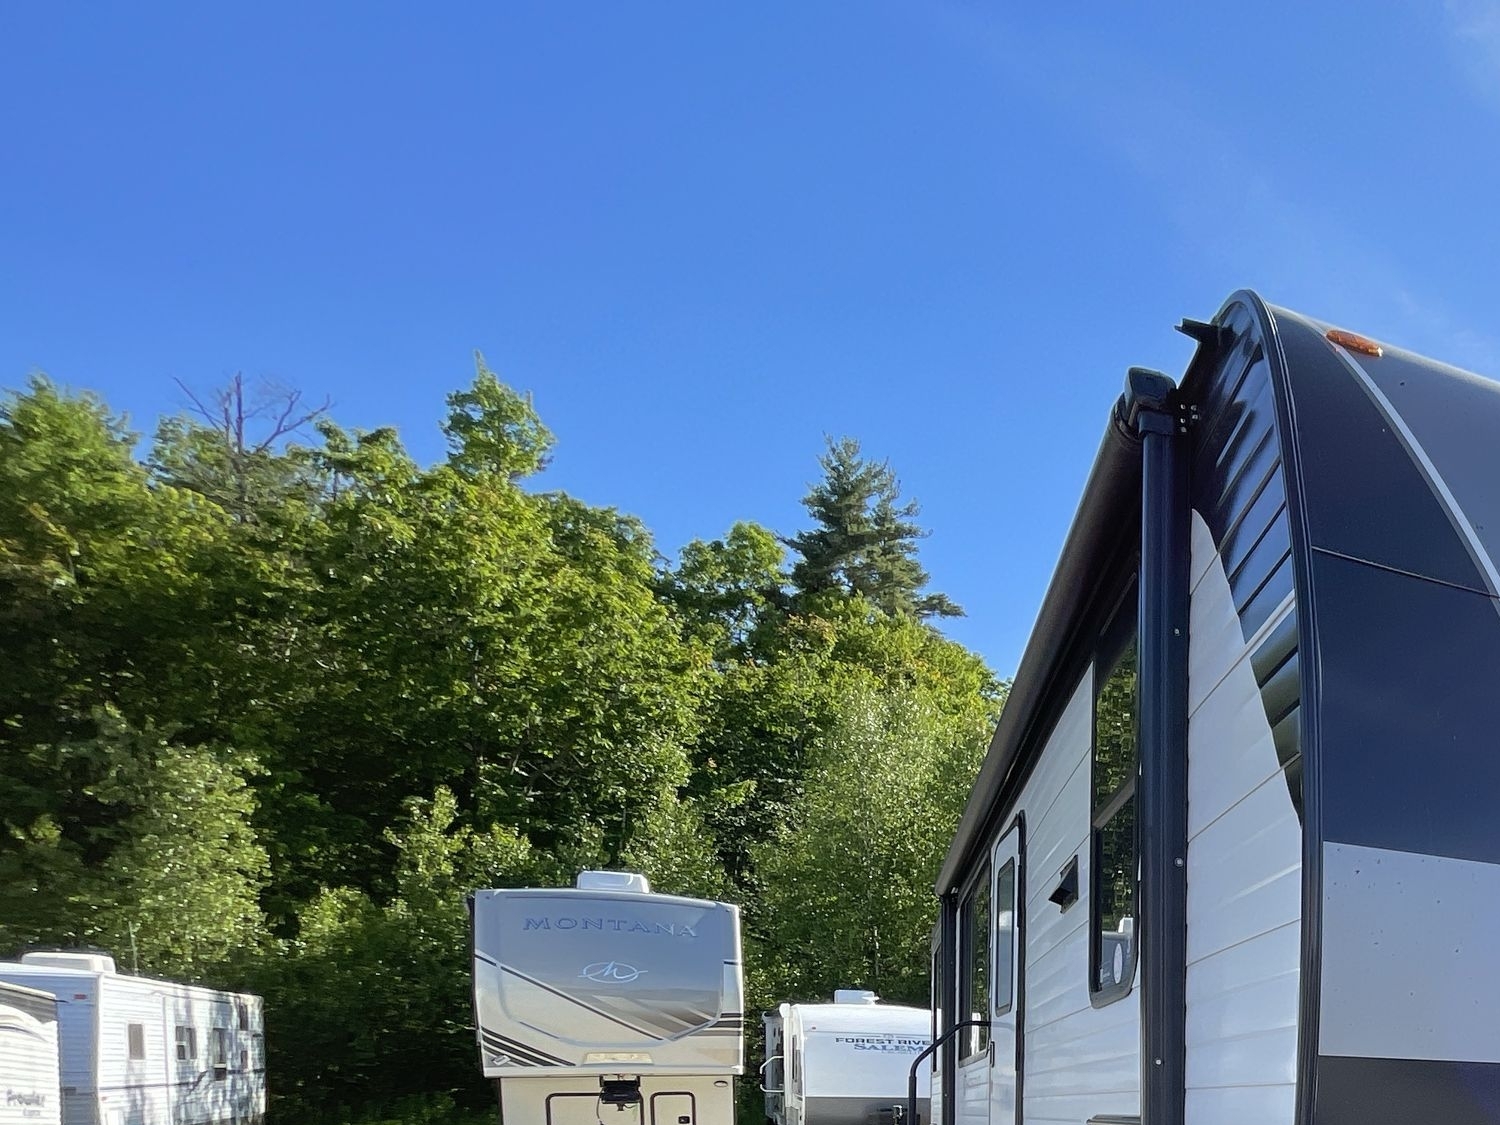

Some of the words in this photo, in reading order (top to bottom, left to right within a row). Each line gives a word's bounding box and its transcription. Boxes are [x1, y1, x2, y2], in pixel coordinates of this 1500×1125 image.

[523, 917, 698, 938] MONTANA
[835, 1037, 892, 1045] FOREST
[853, 1043, 924, 1052] SALEM
